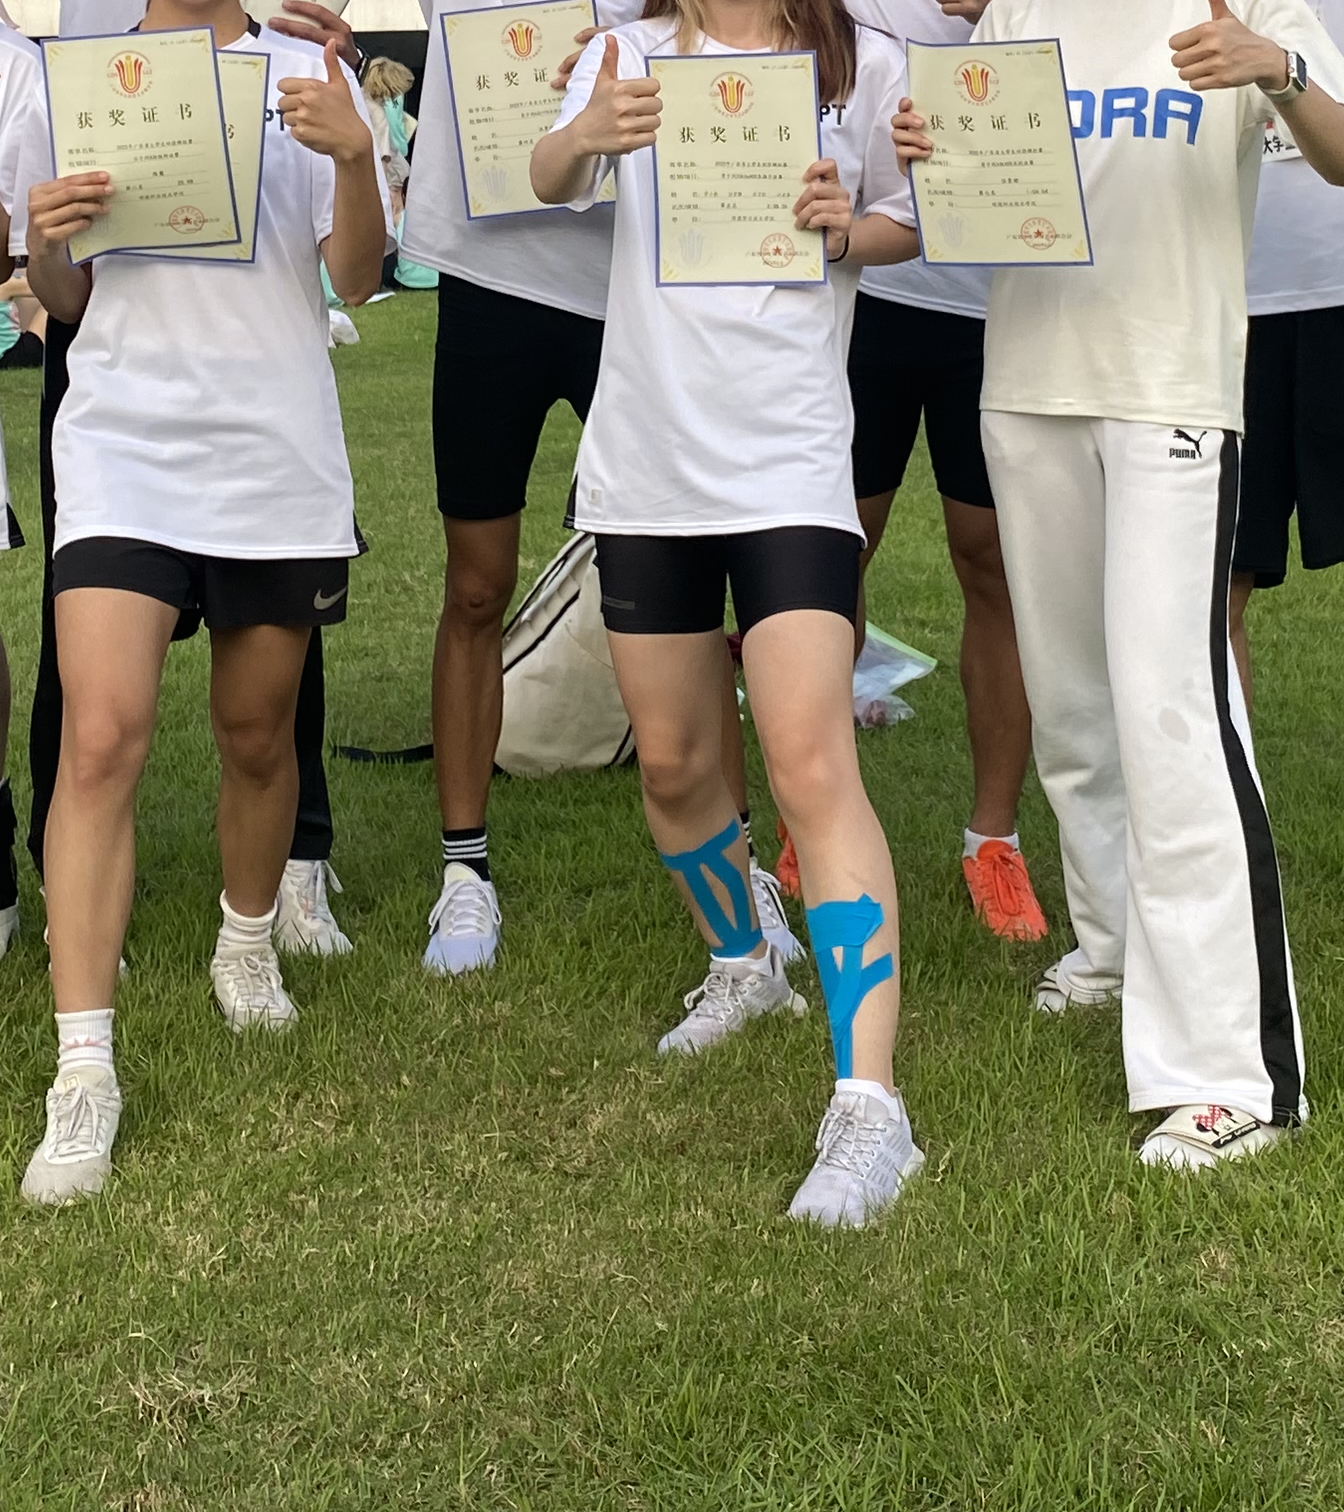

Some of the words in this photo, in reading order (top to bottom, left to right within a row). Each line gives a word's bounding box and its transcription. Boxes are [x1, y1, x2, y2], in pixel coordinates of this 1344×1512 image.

[75, 102, 193, 129] 获奖证书
[929, 112, 1042, 133] 获奖证书
[678, 124, 791, 144] 获奖证书
[1169, 447, 1197, 460] PUMA
